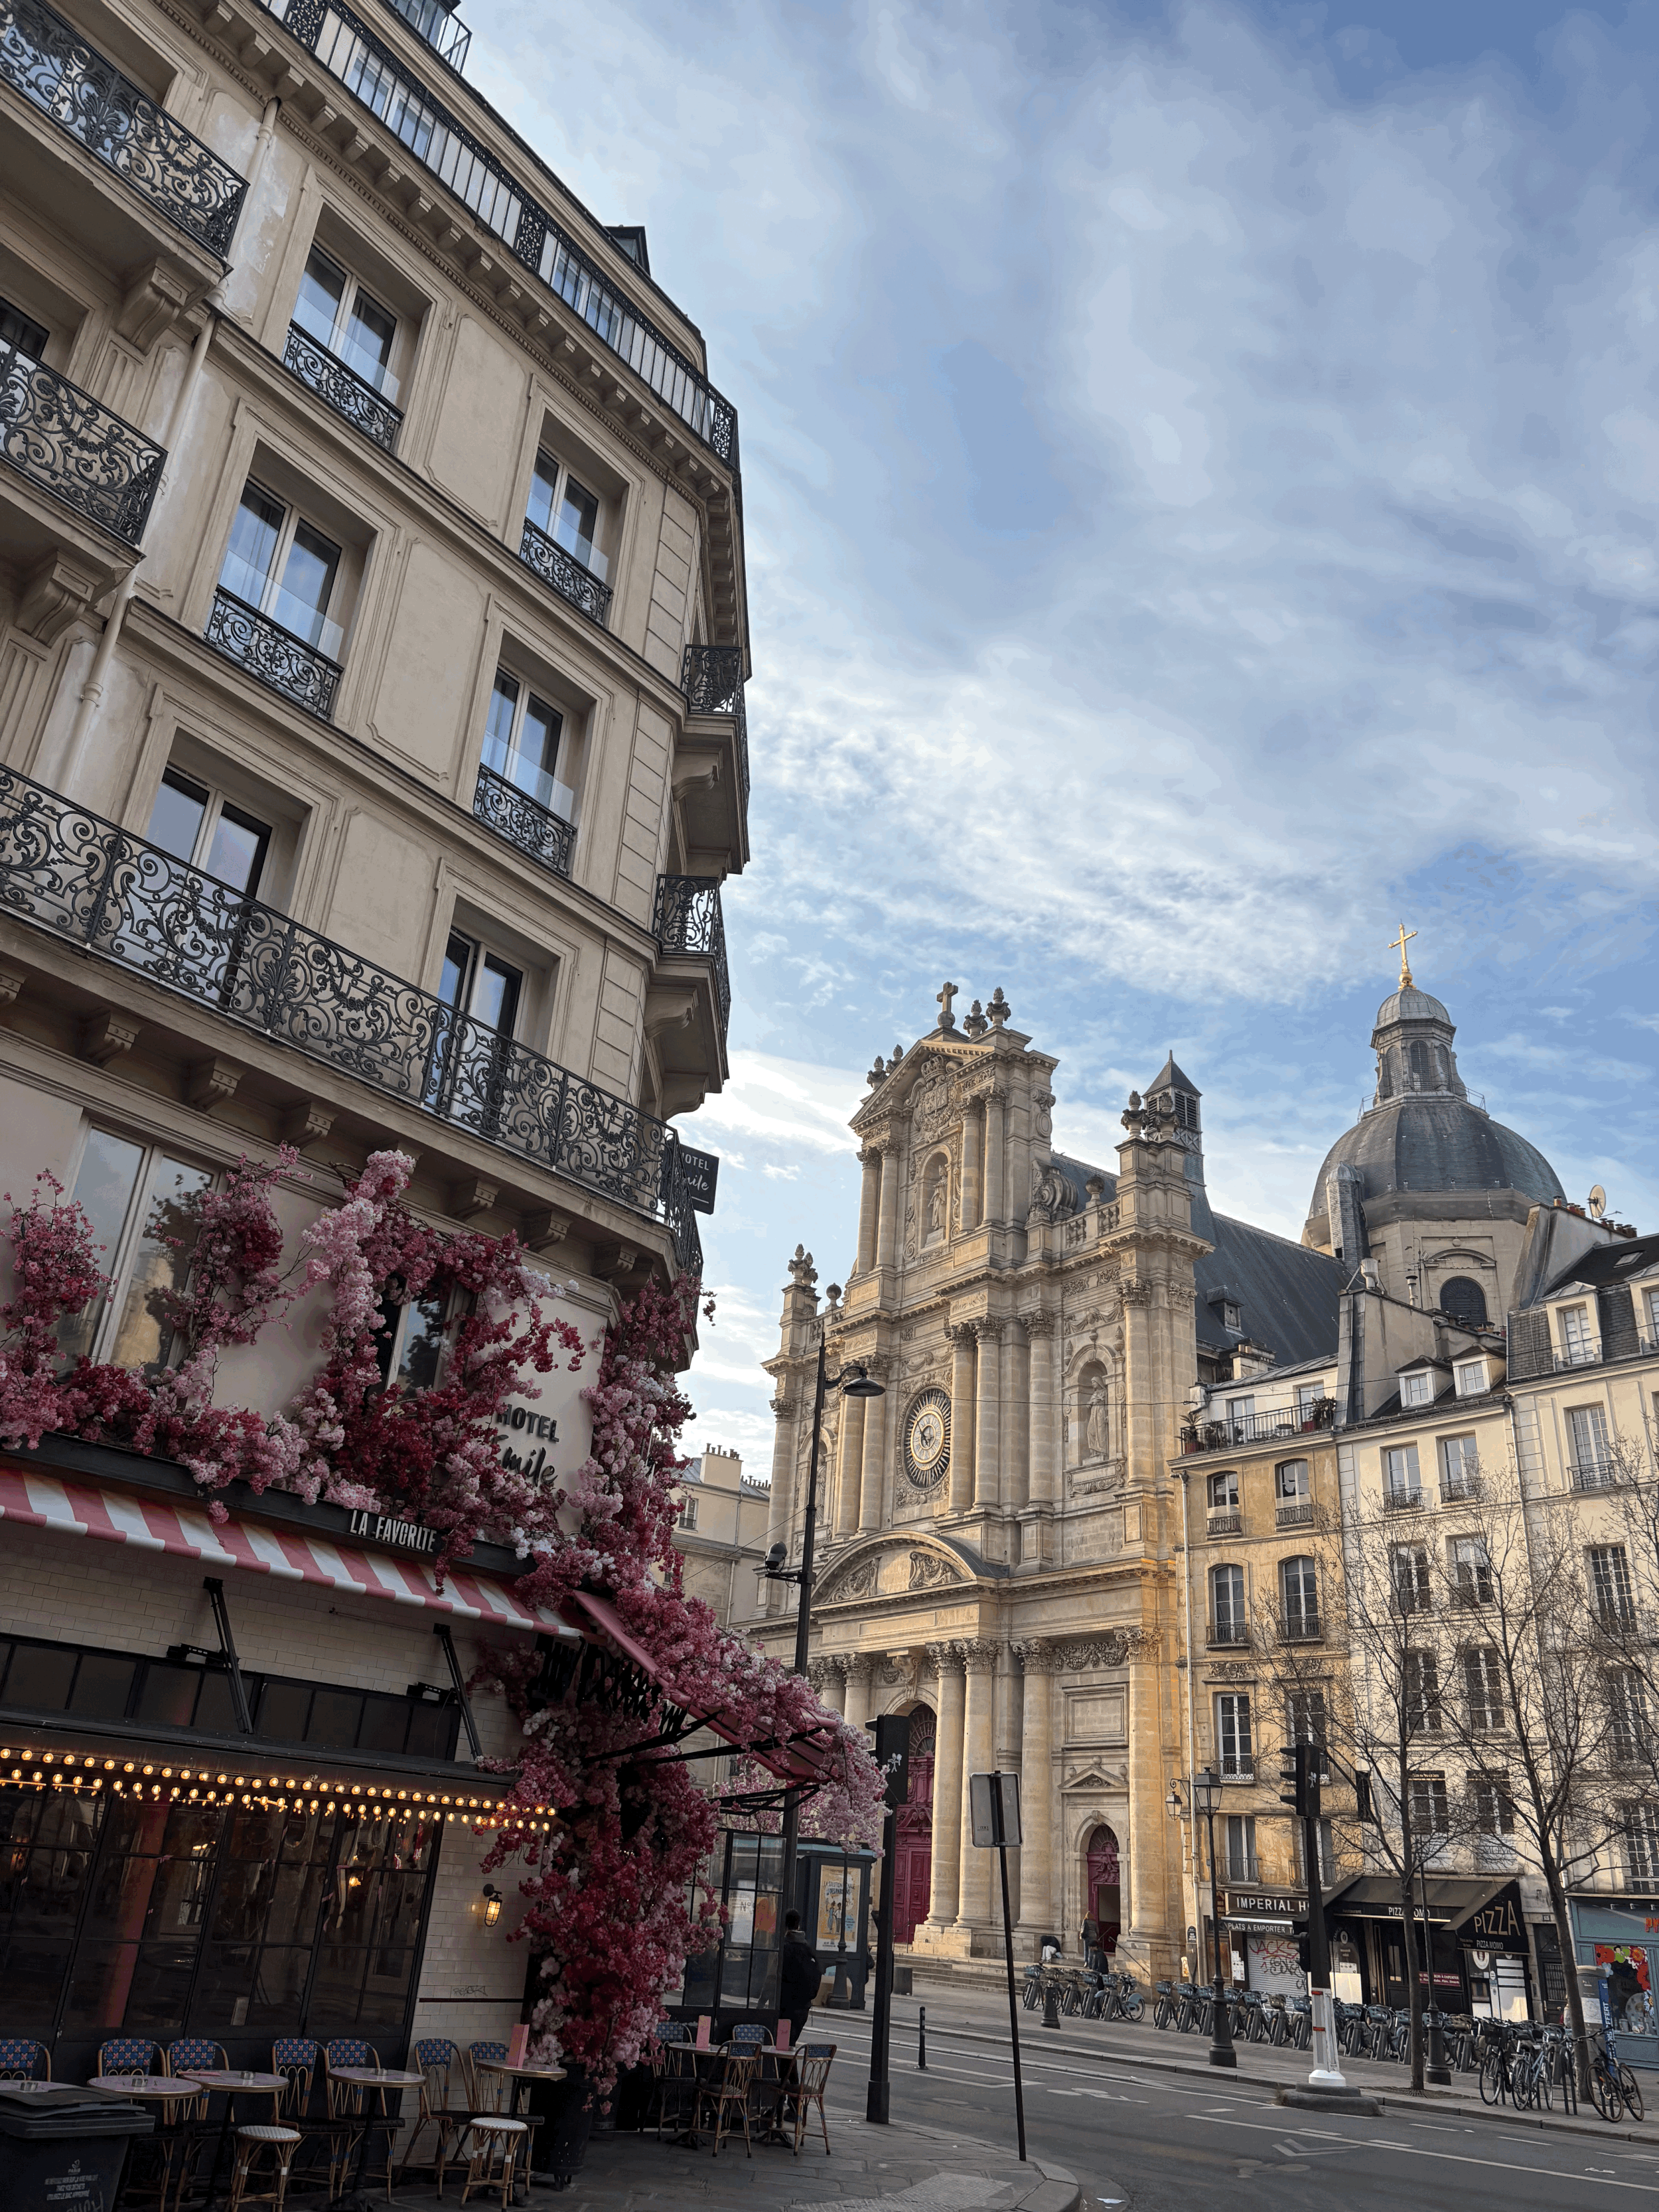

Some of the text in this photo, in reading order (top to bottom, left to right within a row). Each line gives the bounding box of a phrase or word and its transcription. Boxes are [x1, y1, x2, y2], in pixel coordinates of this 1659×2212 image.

[682, 1152, 709, 1171] OTEL
[350, 1510, 437, 1552] LA FAVORITE
[1236, 1897, 1309, 1912] IMPERIAL H
[1474, 1900, 1521, 1936] PIZZA
[1253, 1924, 1285, 1933] EMPORTER
[1476, 1940, 1488, 1949] PIZZA
[1489, 1941, 1504, 1950] MOMO
